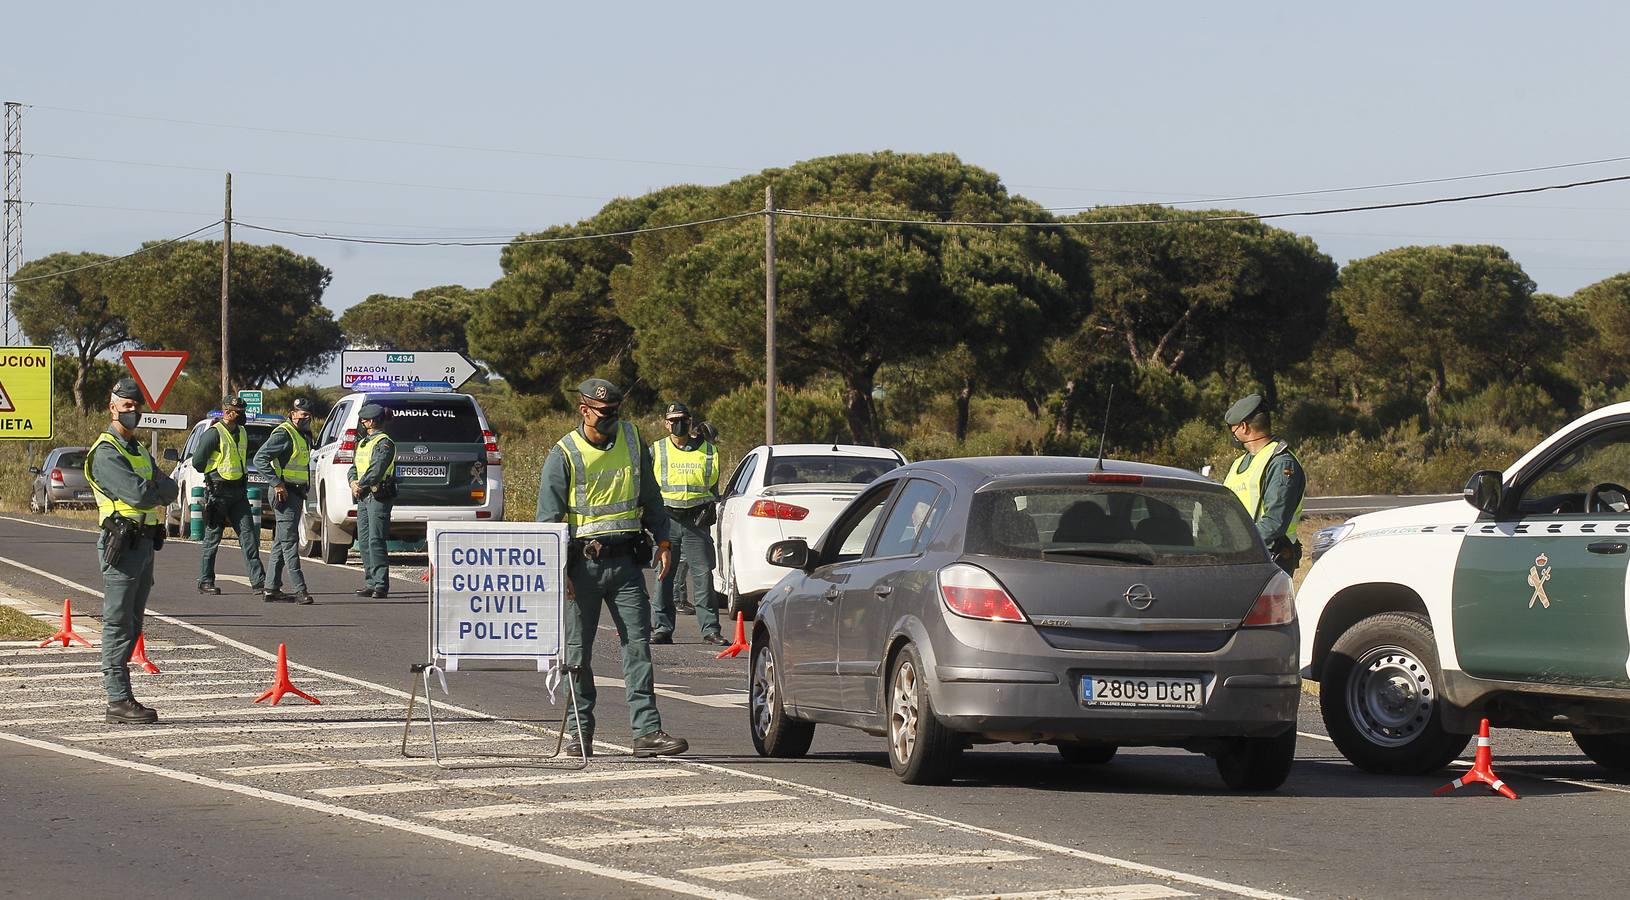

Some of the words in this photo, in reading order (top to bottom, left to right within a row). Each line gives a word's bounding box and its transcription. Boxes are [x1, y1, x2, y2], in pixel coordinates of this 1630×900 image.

[387, 355, 414, 363] A-494
[442, 376, 455, 384] 46
[392, 409, 429, 417] UARDIA
[432, 410, 456, 418] CIVIL
[1, 419, 33, 430] IETA
[451, 548, 546, 566] CONTROL
[452, 574, 545, 592] GUARDIA
[470, 595, 527, 613] CIVIL
[459, 622, 538, 640] POLICE
[1096, 679, 1149, 700] 2809
[1156, 681, 1196, 702] DCR
